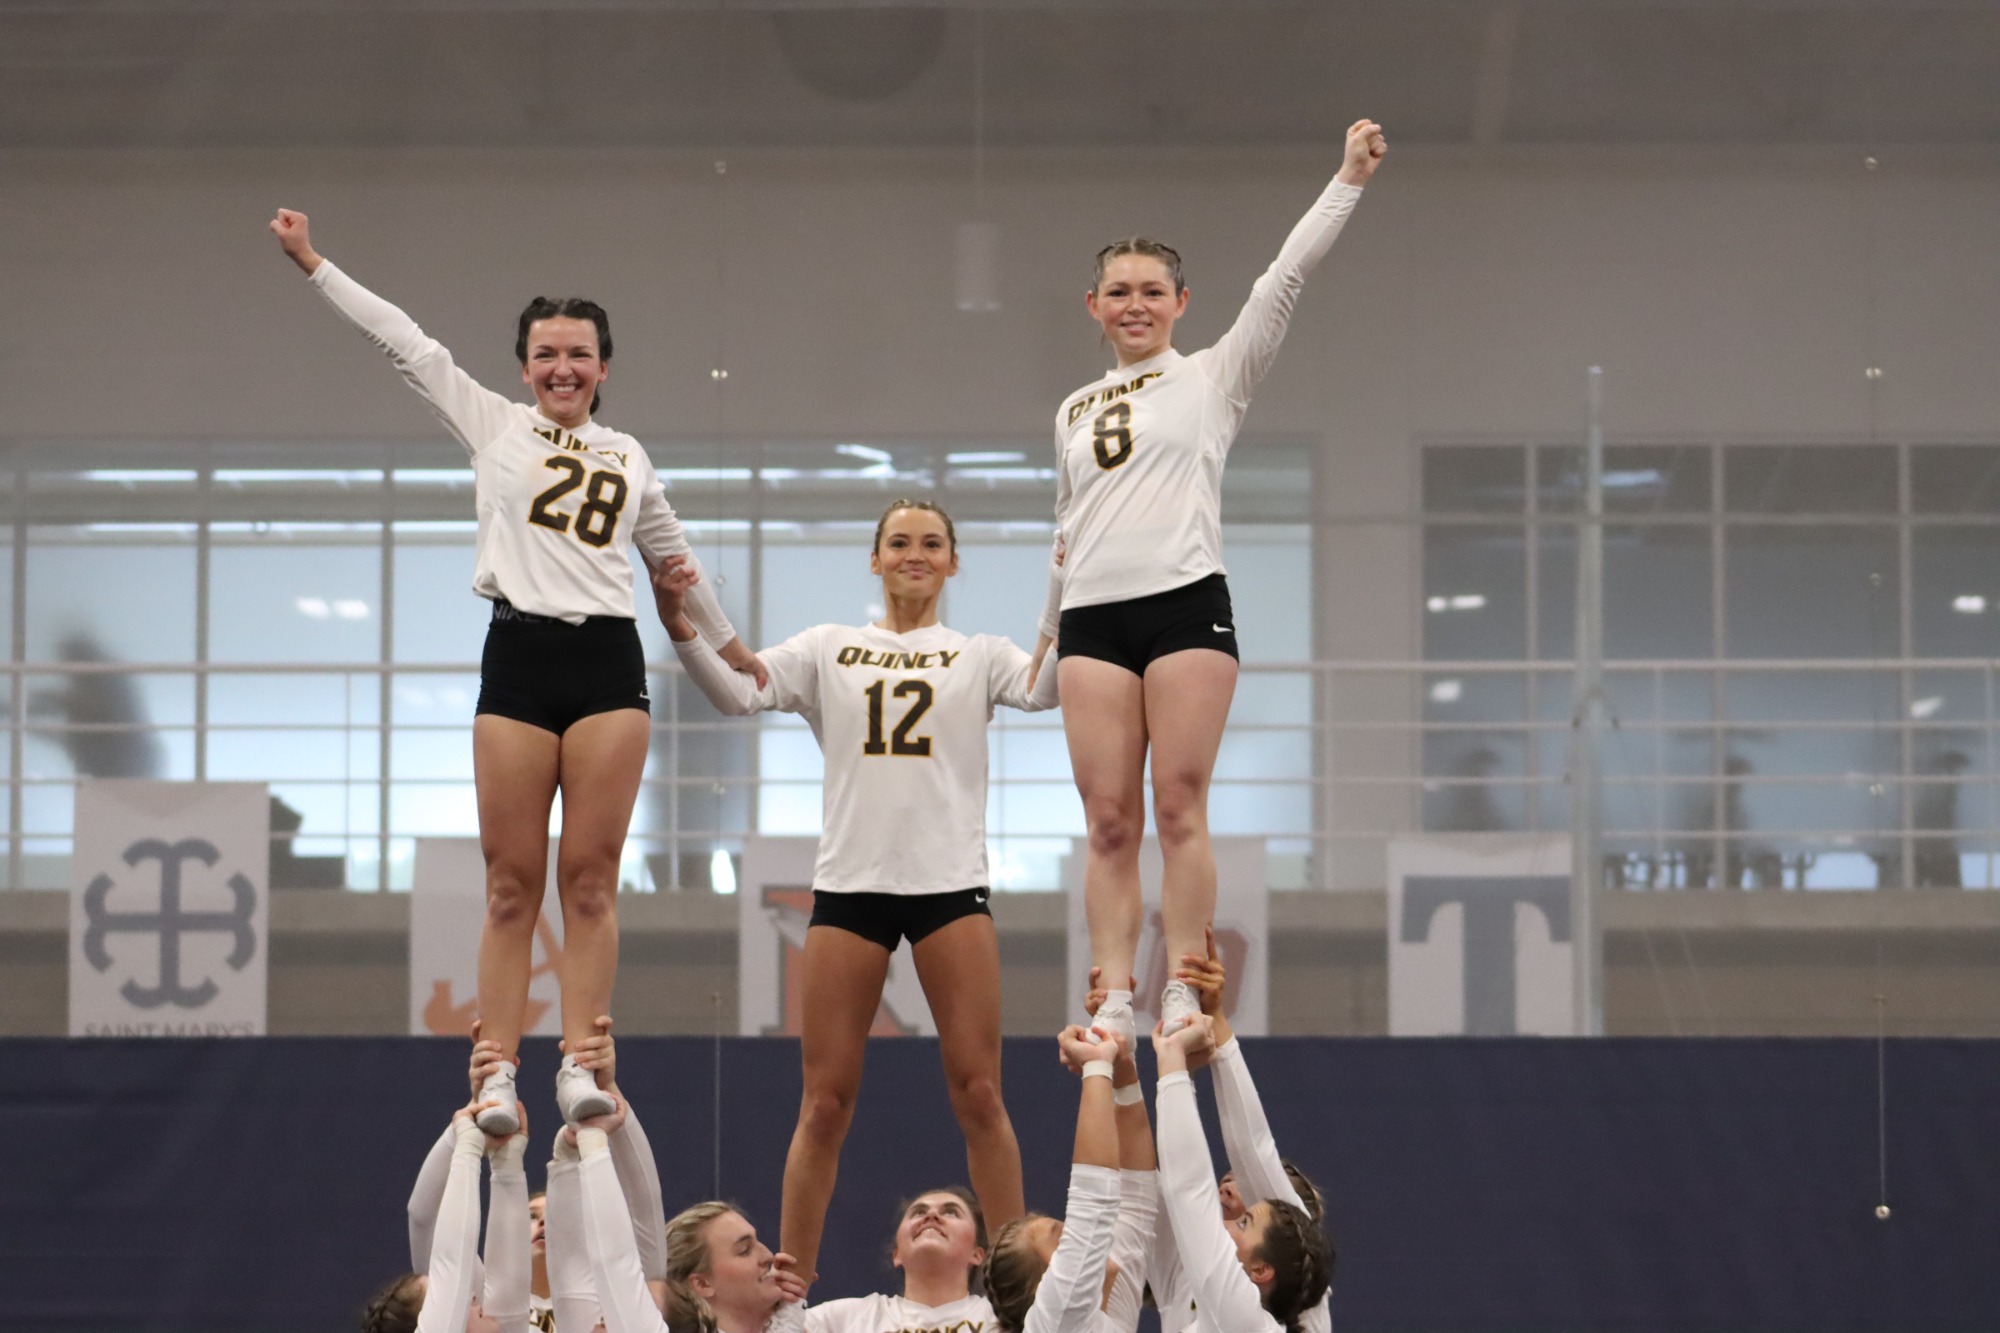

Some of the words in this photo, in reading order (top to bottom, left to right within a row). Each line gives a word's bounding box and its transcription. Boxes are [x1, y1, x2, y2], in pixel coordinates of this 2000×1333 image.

[1093, 400, 1134, 472] 8
[528, 454, 628, 549] 28
[836, 646, 960, 669] QUINCY
[863, 678, 934, 758] 12
[1401, 875, 1570, 1036] T
